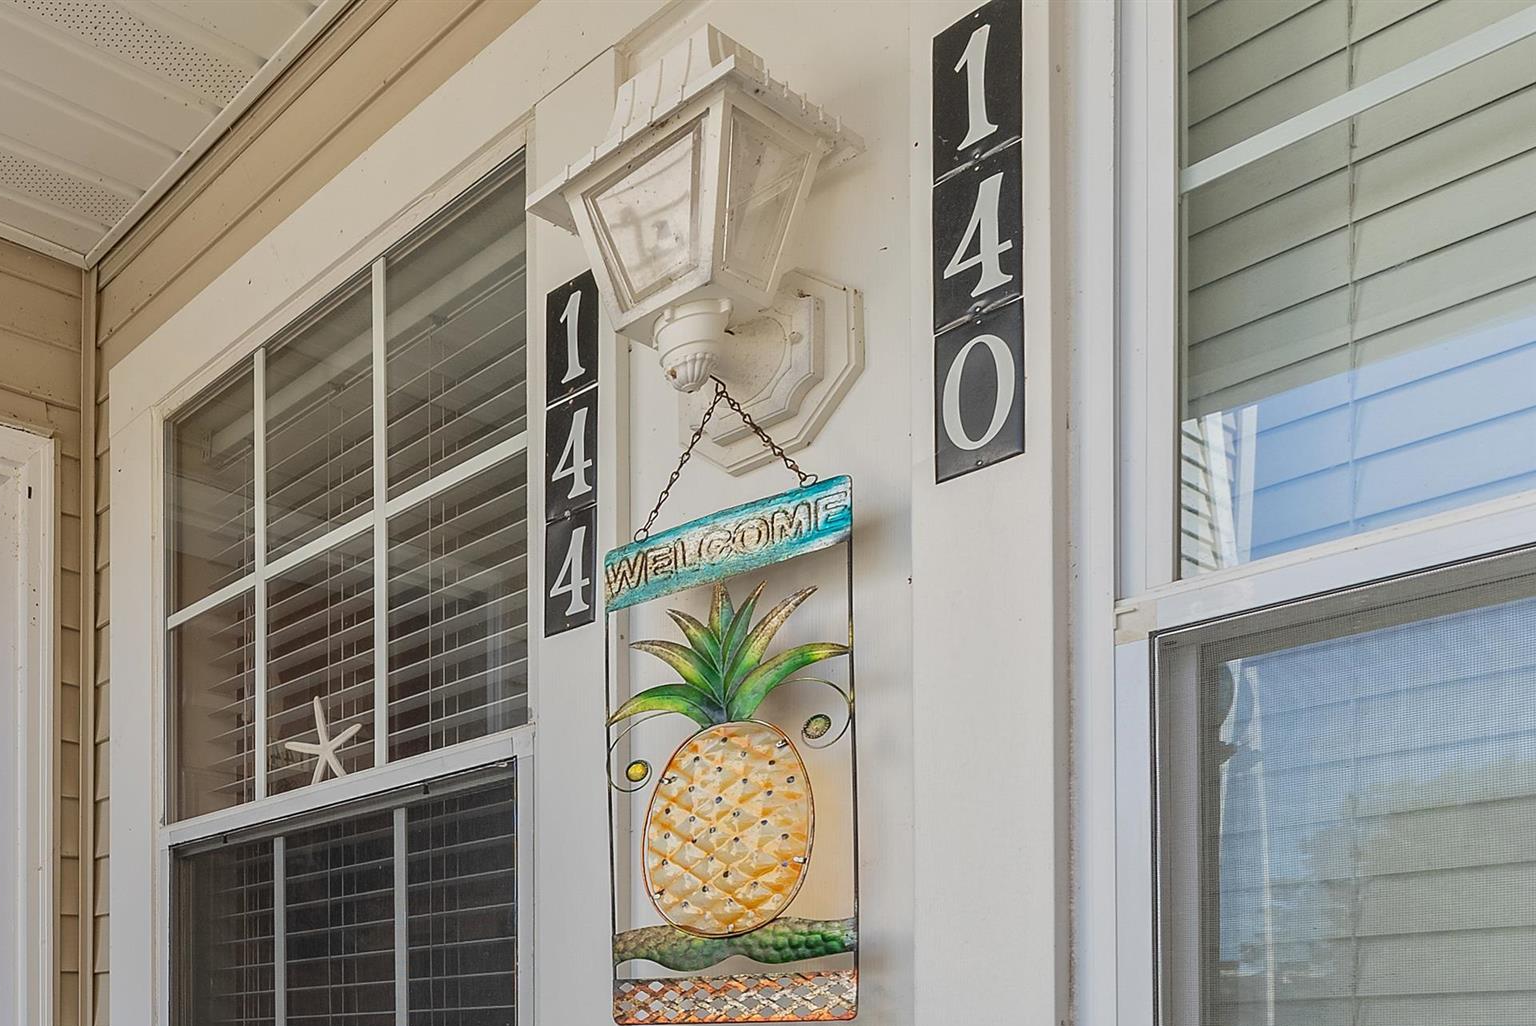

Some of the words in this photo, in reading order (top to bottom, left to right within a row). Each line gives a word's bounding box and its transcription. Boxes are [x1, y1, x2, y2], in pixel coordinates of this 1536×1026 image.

[943, 23, 1017, 452] 140
[549, 289, 593, 617] 144
[605, 490, 848, 599] WELCOME
